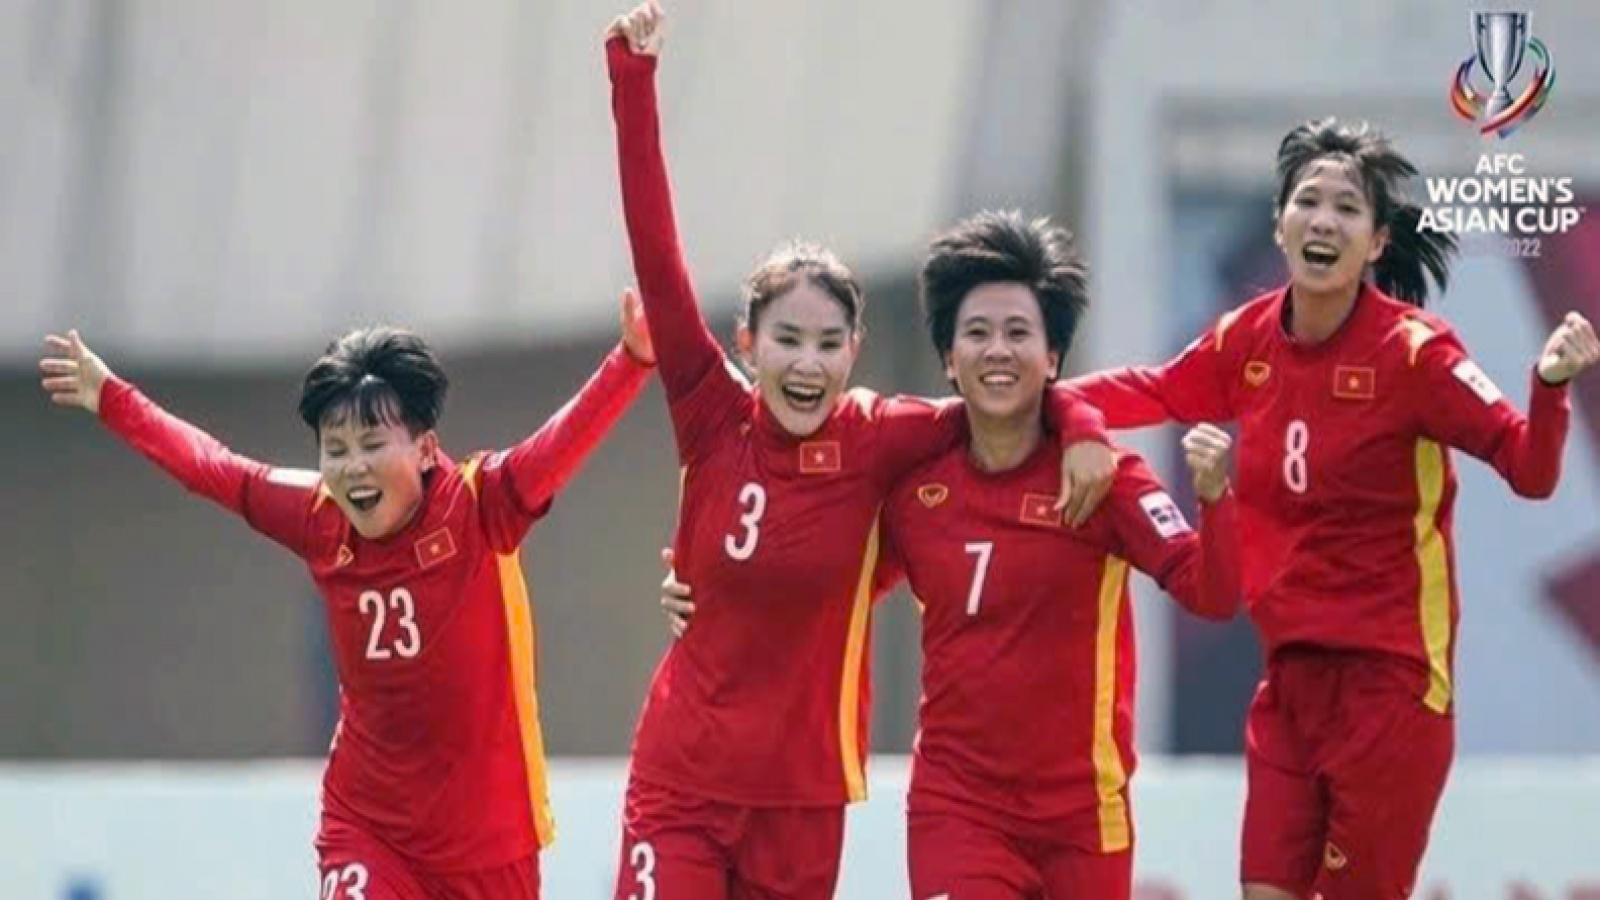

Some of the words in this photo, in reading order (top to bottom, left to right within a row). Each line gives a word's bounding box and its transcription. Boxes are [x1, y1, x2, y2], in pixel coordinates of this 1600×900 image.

[1283, 419, 1309, 493] 8
[724, 481, 766, 561] 3
[964, 541, 994, 615] 7
[358, 587, 420, 659] 23
[627, 841, 656, 900] 3
